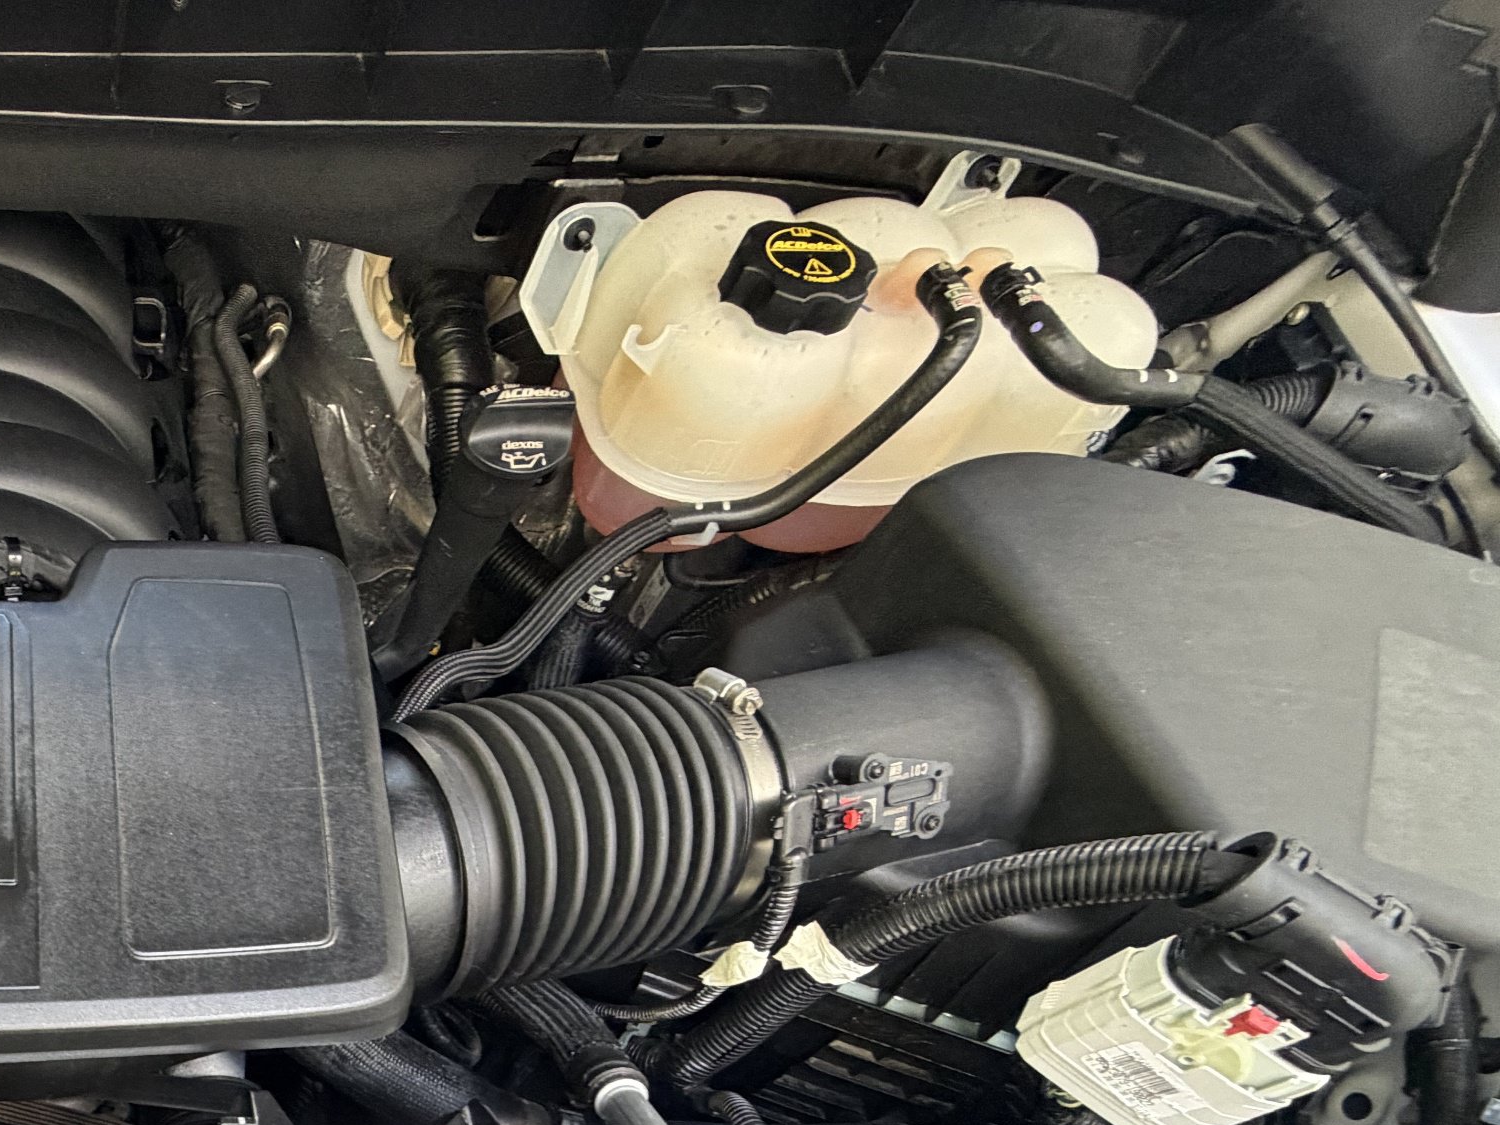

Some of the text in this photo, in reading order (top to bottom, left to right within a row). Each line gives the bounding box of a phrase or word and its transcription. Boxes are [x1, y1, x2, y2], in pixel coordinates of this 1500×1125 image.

[772, 240, 844, 250] ACDelco
[497, 388, 570, 399] ACDelco
[501, 440, 544, 450] dexos
